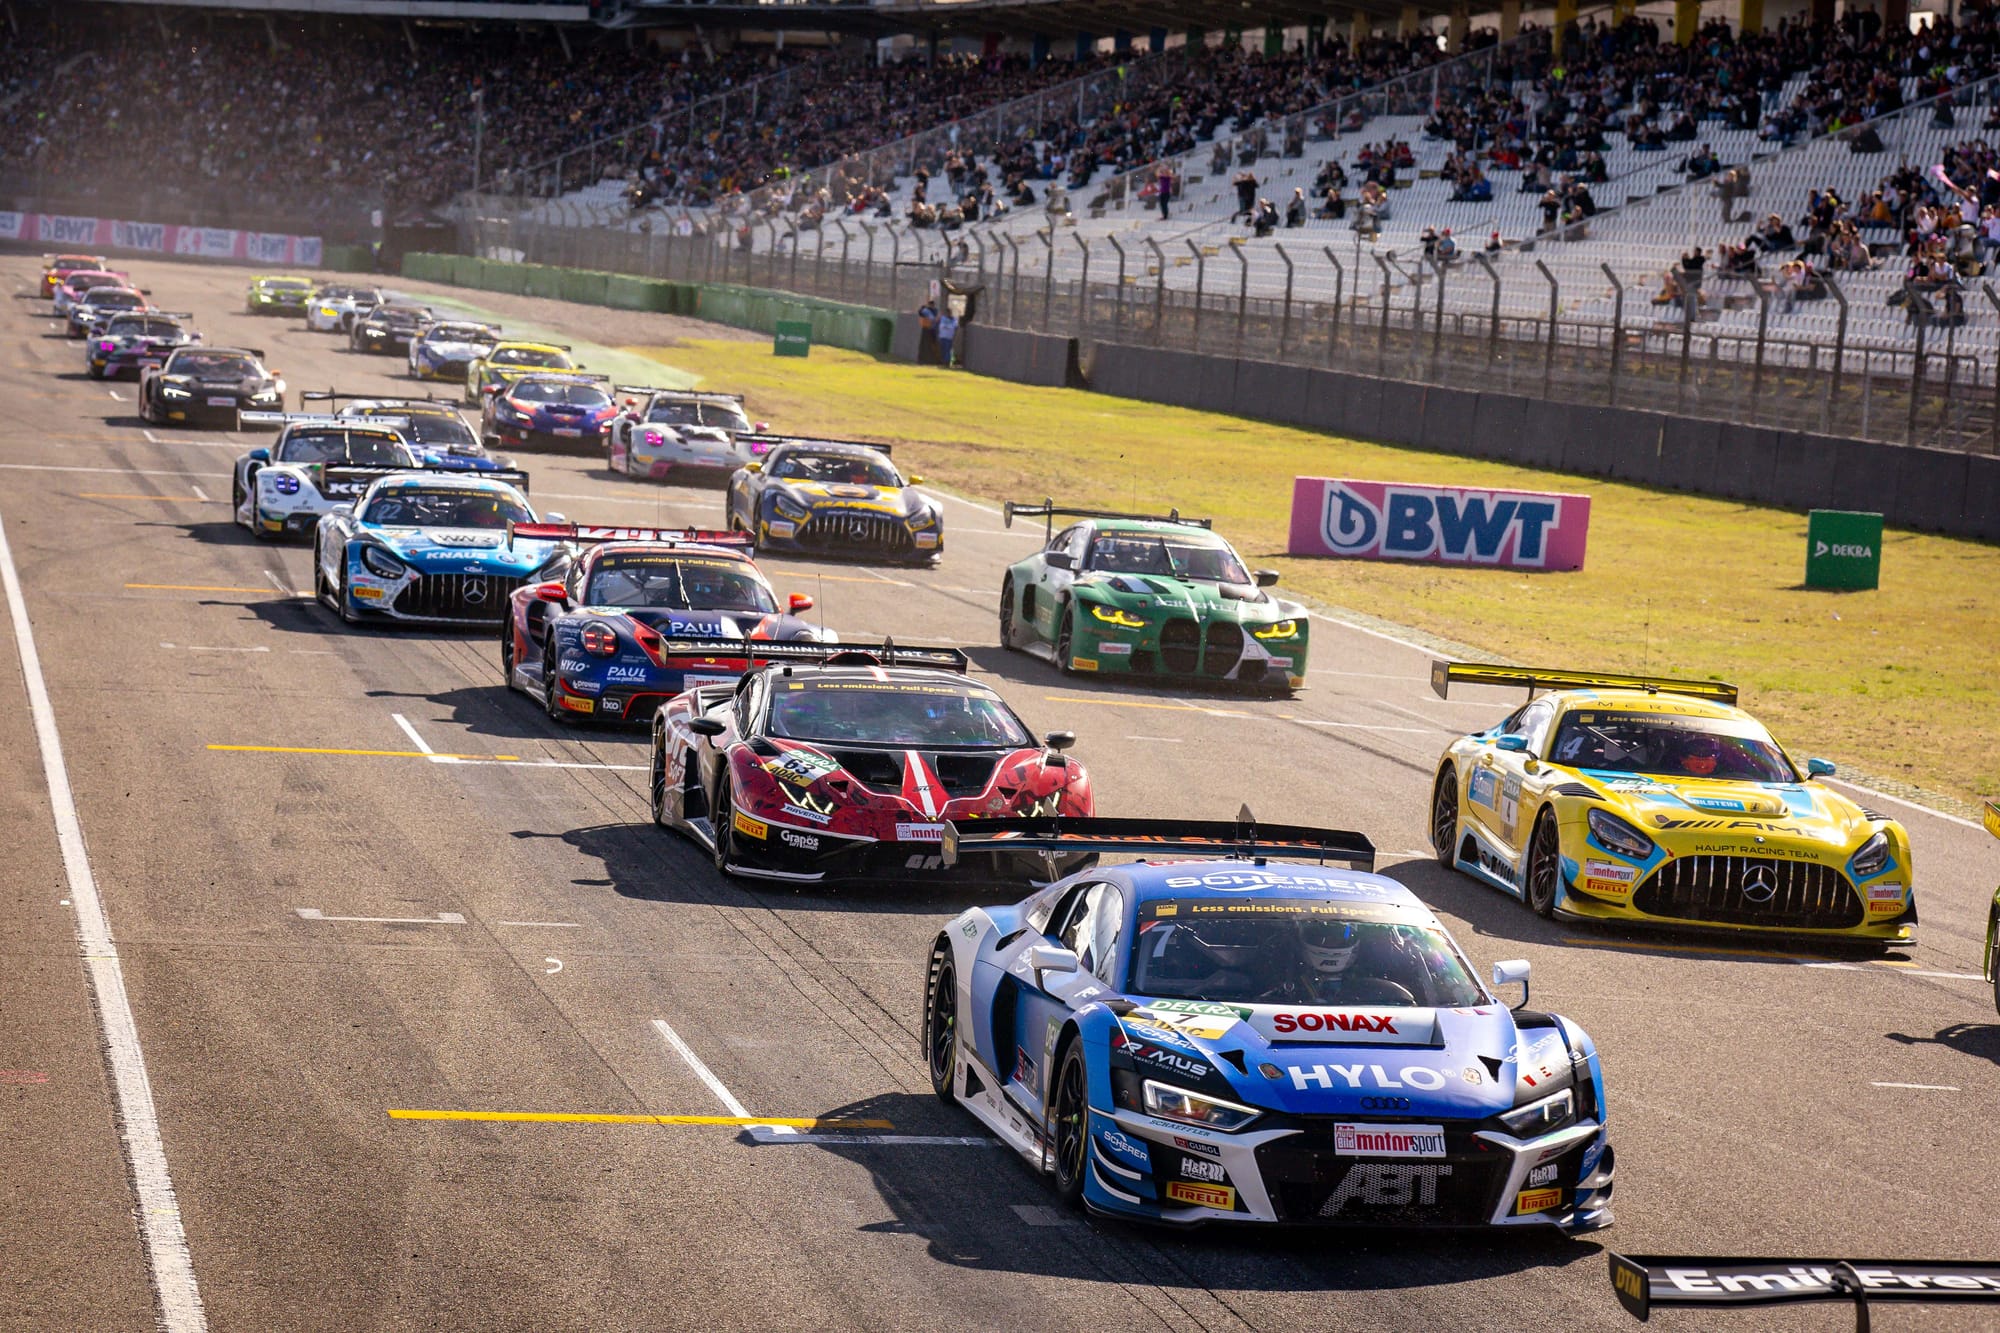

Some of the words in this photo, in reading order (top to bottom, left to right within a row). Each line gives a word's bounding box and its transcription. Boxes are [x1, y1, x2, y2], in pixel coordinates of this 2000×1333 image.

[53, 219, 95, 243] BWT
[376, 504, 400, 520] 22
[1386, 493, 1555, 561] BWT
[426, 552, 488, 560] KNAUS
[1832, 543, 1872, 559] DEKRA
[671, 622, 722, 634] PAUL
[697, 641, 819, 653] LAMBORGHINI
[560, 659, 586, 672] HYLO
[607, 666, 647, 677] PAUL
[842, 683, 898, 691] emissions.
[922, 686, 957, 694] Speed.
[1562, 737, 1583, 759] 4
[783, 758, 817, 775] 63
[789, 749, 838, 772] DEKRA
[769, 766, 803, 783] ADAC
[786, 806, 826, 821] RAVENOL
[737, 816, 763, 836] PIRELLI
[1695, 844, 1737, 852] HAUPT
[1739, 845, 1786, 857] RACING
[1789, 850, 1820, 860] TEAM
[1593, 867, 1634, 880] motorsport
[1165, 875, 1388, 895] SCHERER
[1586, 879, 1628, 894] PIRELLI
[1192, 905, 1225, 913] Less
[1227, 904, 1307, 914] emissions.
[1310, 905, 1338, 914] Full
[1151, 925, 1176, 958] 7
[1149, 1000, 1241, 1016] DEKRA
[1173, 1013, 1199, 1024] 7
[1273, 1013, 1399, 1035] SONAX
[1287, 1064, 1446, 1091] HYLO
[1150, 1119, 1211, 1137] SCHAEFFLER
[1103, 1130, 1148, 1161] SCHERER
[1356, 1131, 1445, 1155] motorsport
[1181, 1157, 1208, 1177] H&R
[1171, 1182, 1229, 1206] PIRELLI
[1318, 1163, 1453, 1217] ABT
[1521, 1190, 1559, 1210] PIRELLI
[1615, 1266, 1642, 1298] DTM
[1665, 1266, 1832, 1293] Emil
